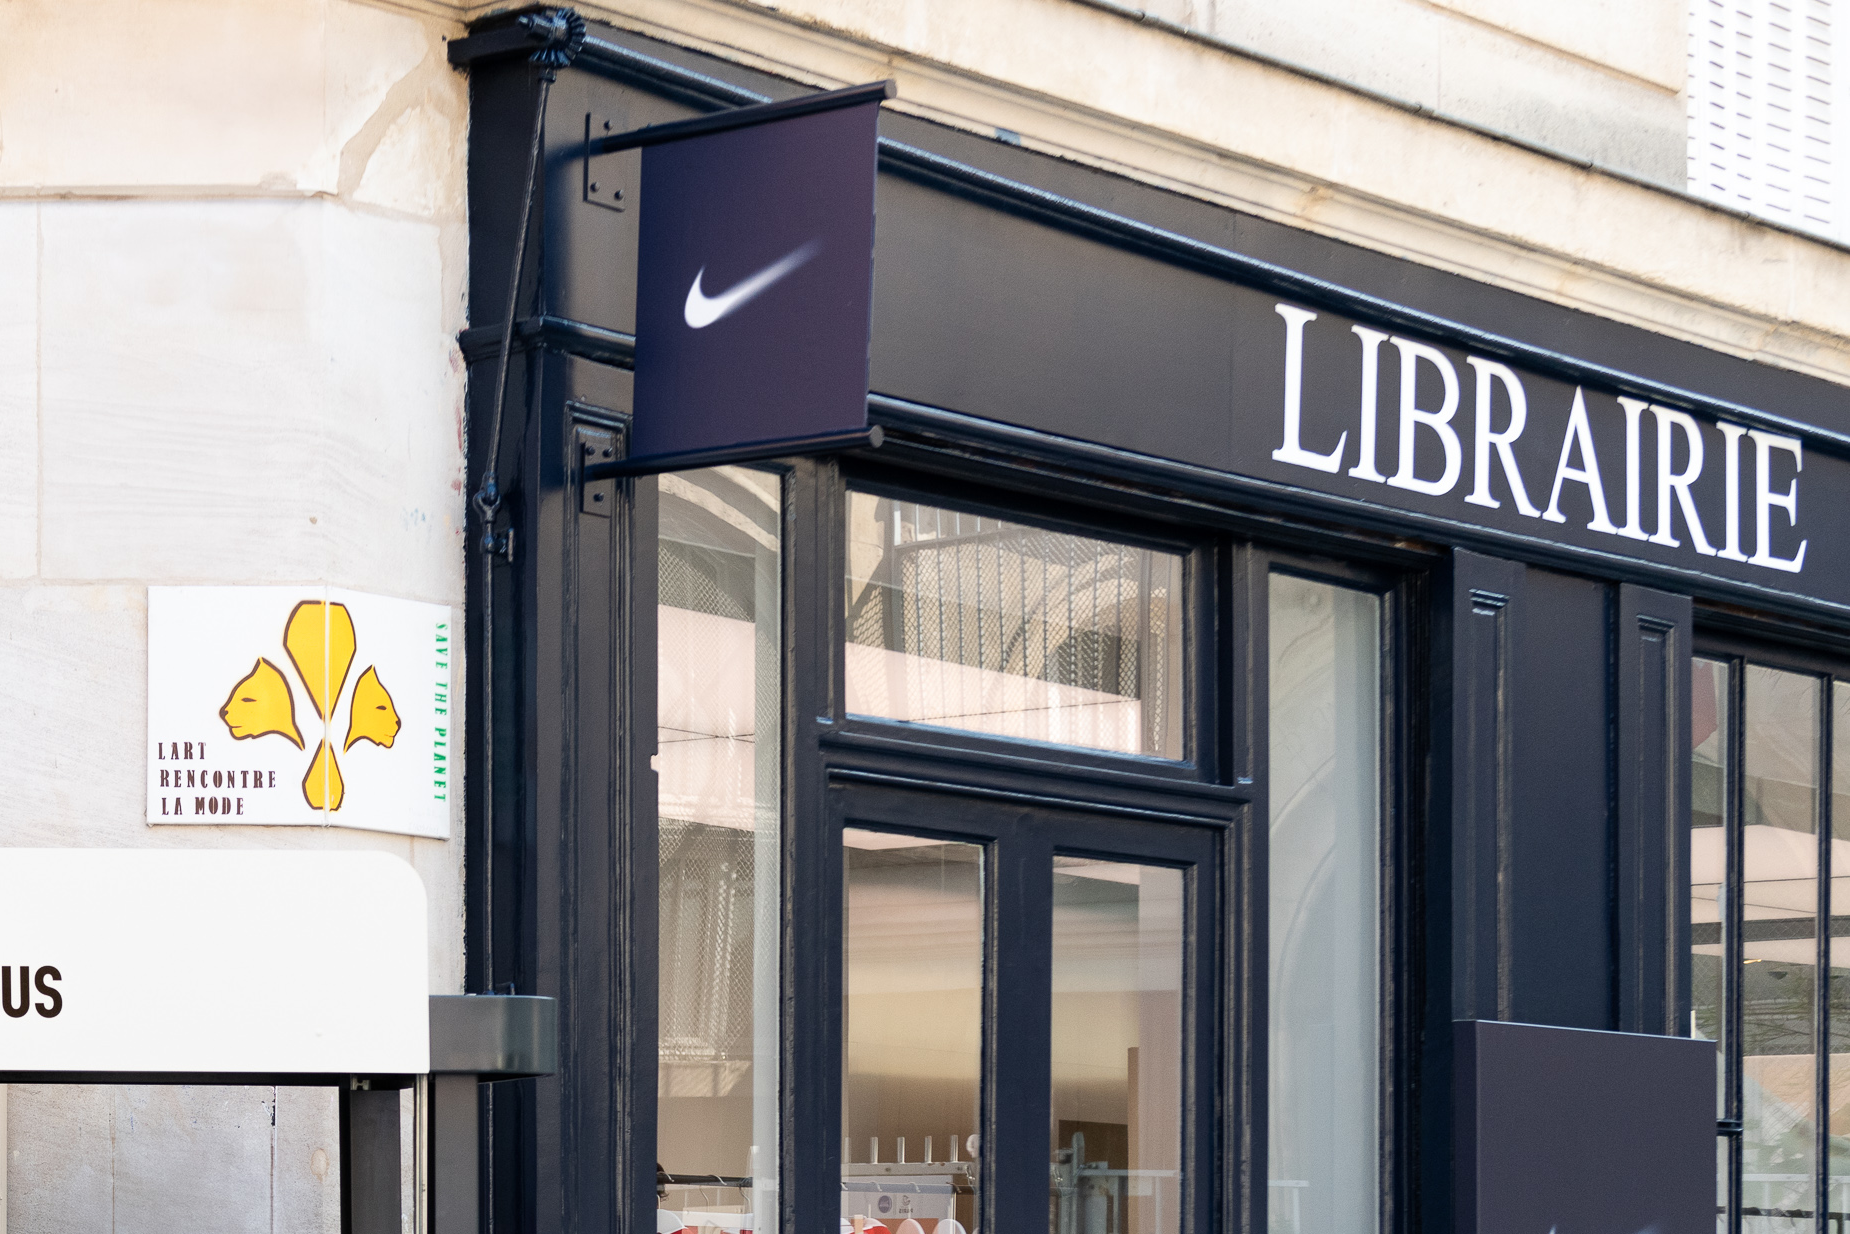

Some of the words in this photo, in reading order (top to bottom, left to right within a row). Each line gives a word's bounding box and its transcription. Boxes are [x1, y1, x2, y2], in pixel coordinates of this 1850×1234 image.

[1272, 303, 1808, 574] LIBRAIRIE
[435, 622, 448, 669] SAVE
[434, 682, 448, 715] THE
[158, 741, 206, 760] LART
[433, 727, 447, 802] PLANET
[160, 769, 276, 789] RENCONTRE
[162, 797, 183, 816] LA
[195, 796, 244, 816] MODE
